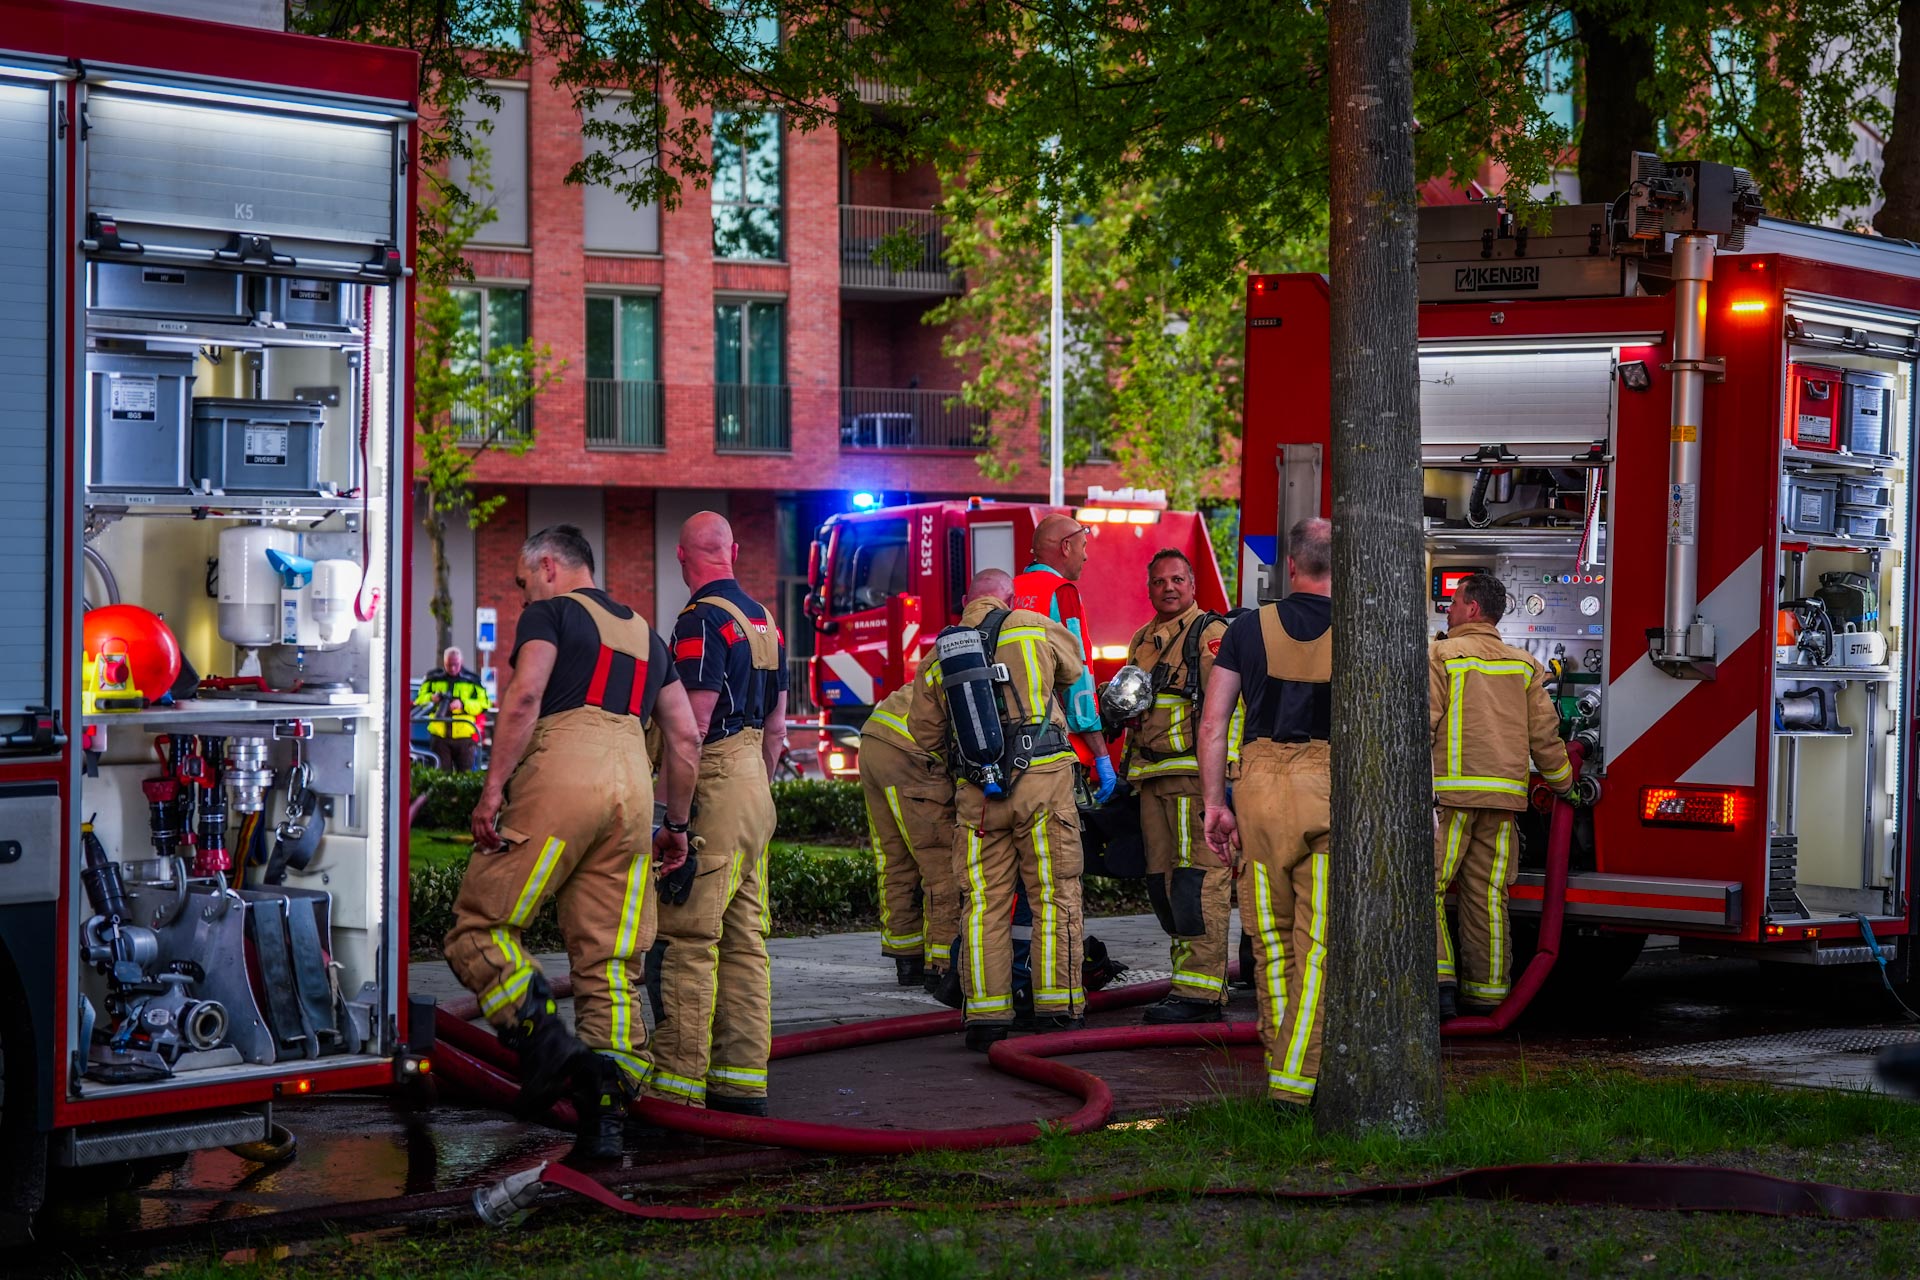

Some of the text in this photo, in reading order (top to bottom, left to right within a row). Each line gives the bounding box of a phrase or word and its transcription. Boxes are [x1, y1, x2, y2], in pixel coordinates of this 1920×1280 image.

[234, 203, 254, 220] K5
[1478, 266, 1540, 283] KENBRI
[298, 291, 322, 300] DIVERSE
[254, 456, 278, 464] DIVERSE
[921, 515, 933, 576] 22-2351
[854, 619, 888, 629] BRANDW
[1850, 643, 1872, 655] STIHL
